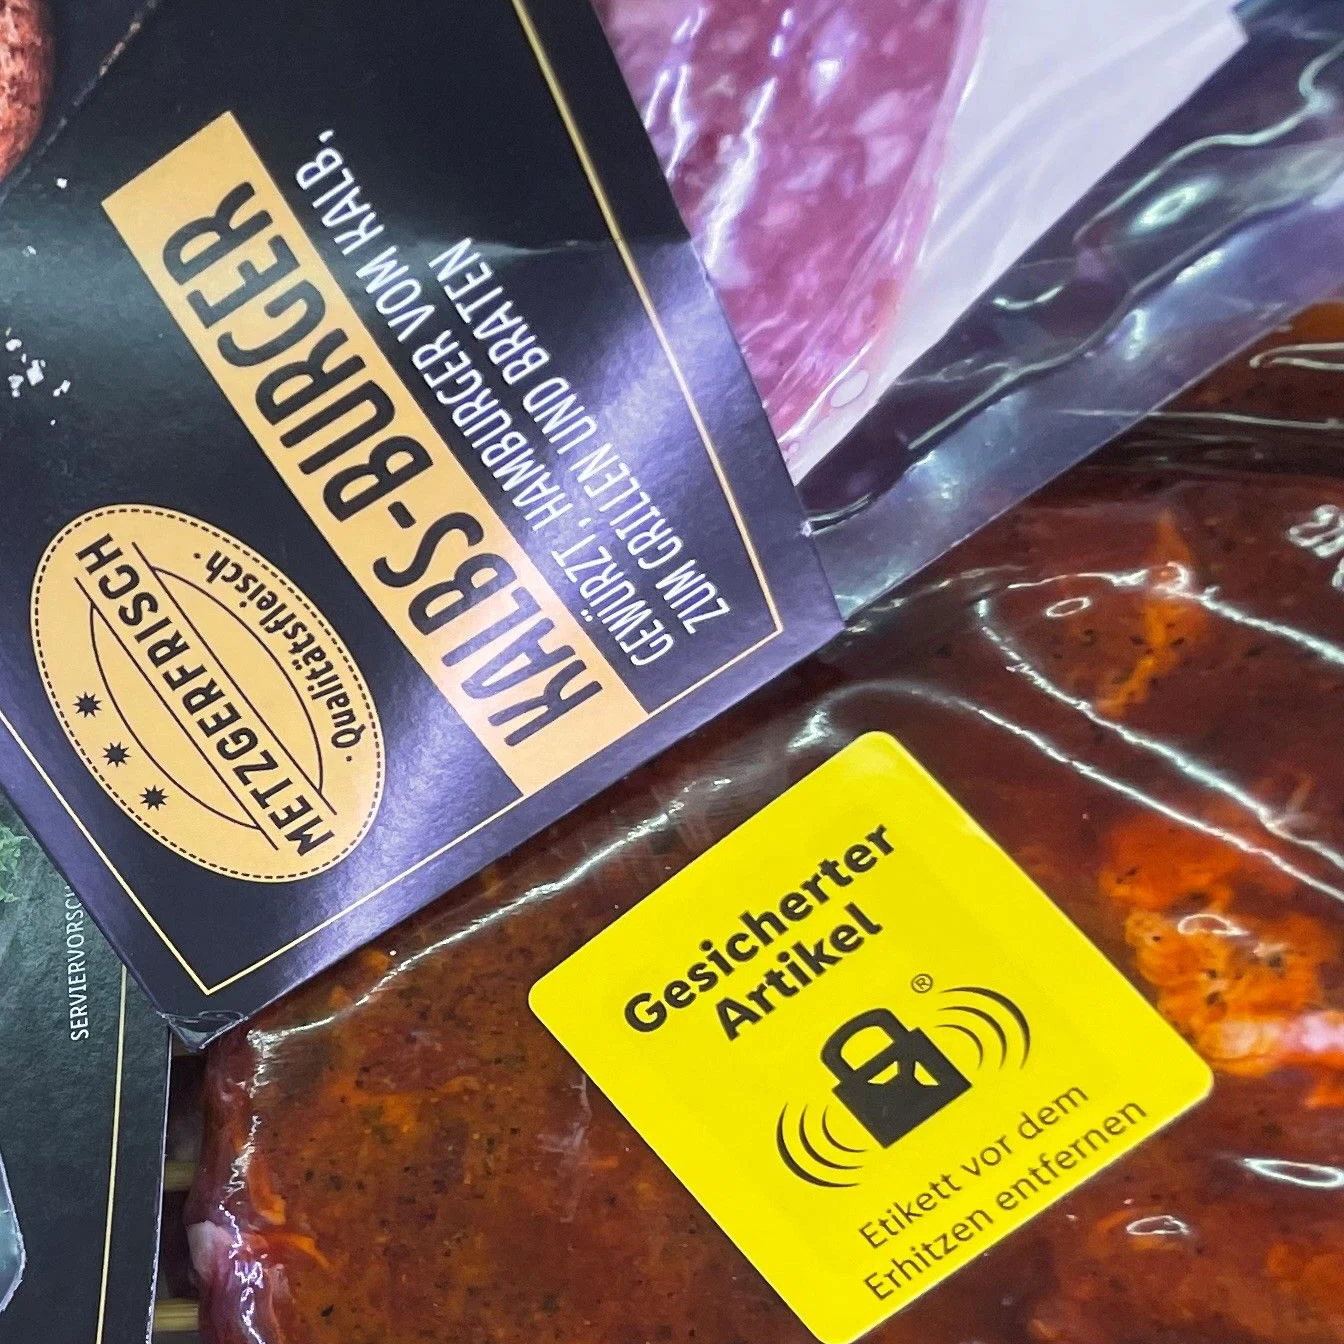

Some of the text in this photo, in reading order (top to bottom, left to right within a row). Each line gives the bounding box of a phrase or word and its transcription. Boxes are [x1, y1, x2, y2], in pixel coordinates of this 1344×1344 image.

[162, 181, 601, 747] KALBS-BURGER
[296, 129, 674, 666] GEWÜRZT, HAMBURGER VOM KALB,
[428, 237, 730, 634] ZUM GRILLEN UND BRATEN
[75, 533, 336, 857] METZGERFRISCH
[205, 550, 366, 749] Qualitätsfleisch
[624, 824, 896, 1033] Gesicherter
[714, 903, 883, 1040] Artikel
[858, 1087, 1089, 1249] Etikett vor dem
[864, 1101, 1148, 1301] Erhitzen entfernen
